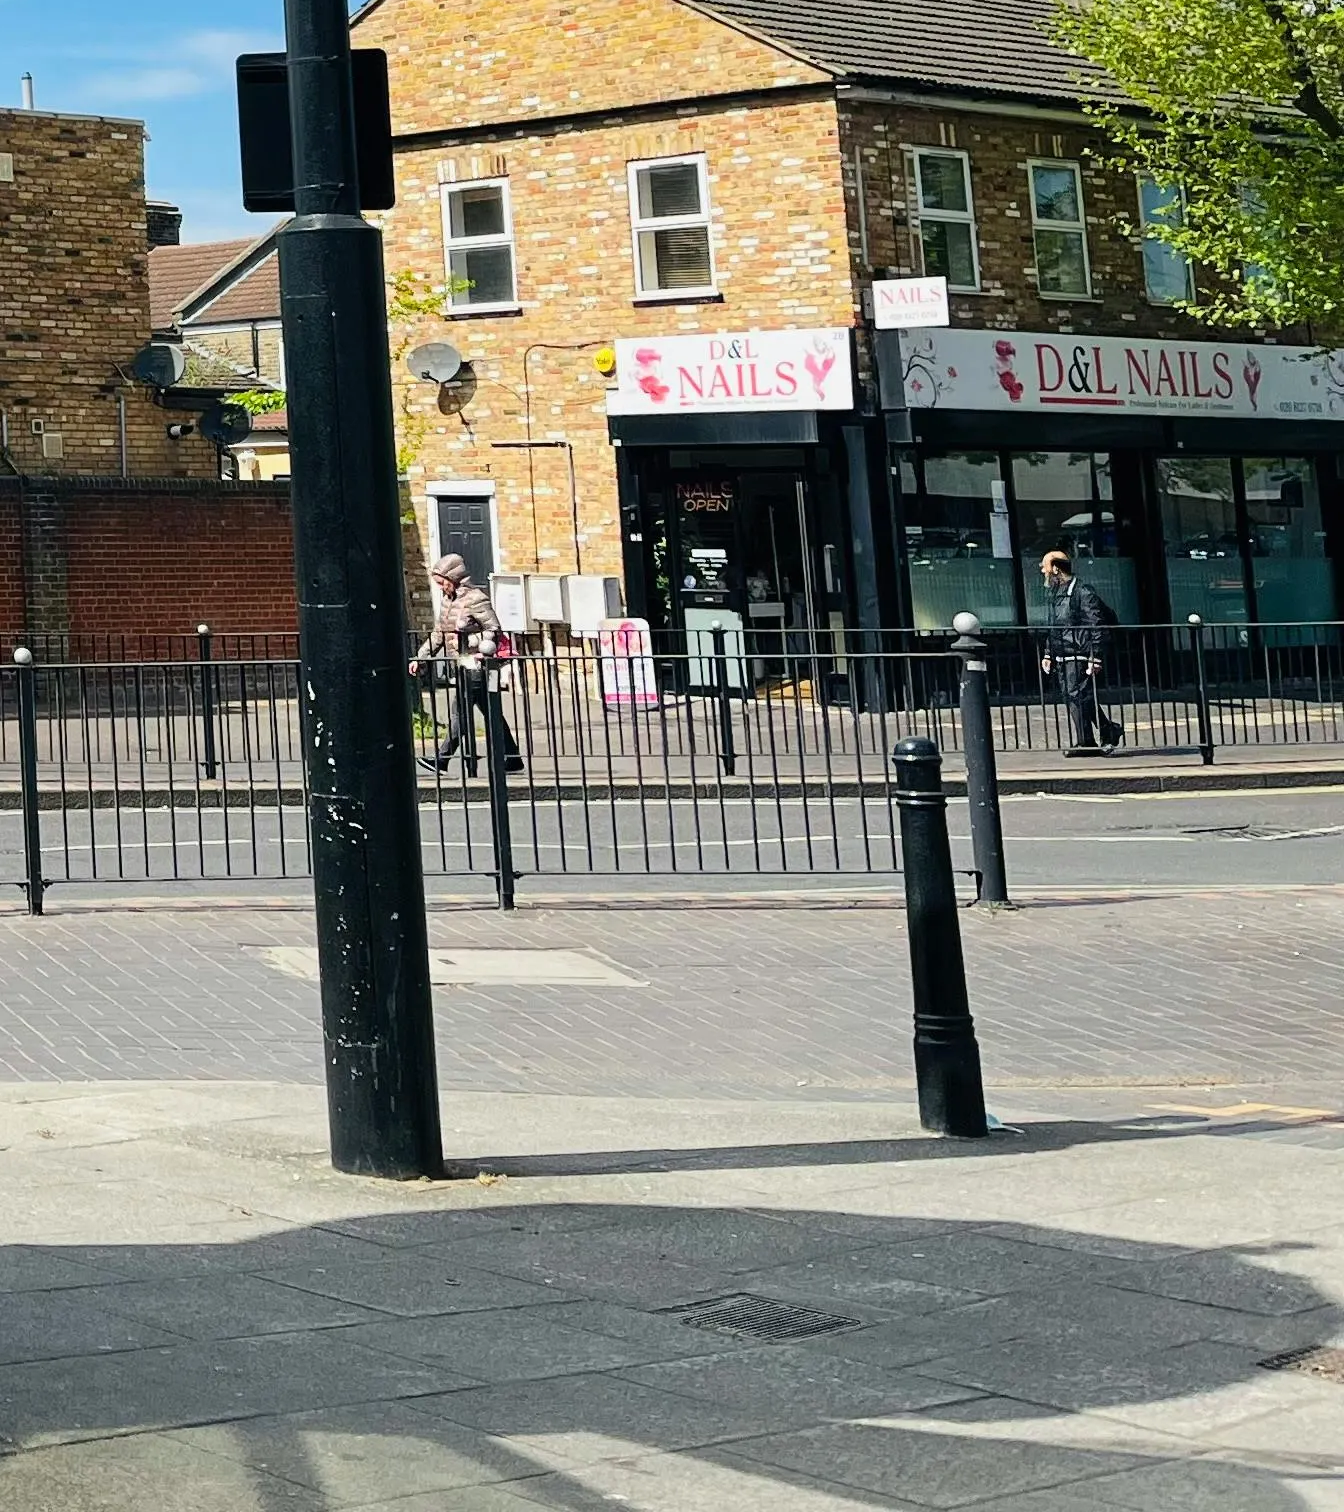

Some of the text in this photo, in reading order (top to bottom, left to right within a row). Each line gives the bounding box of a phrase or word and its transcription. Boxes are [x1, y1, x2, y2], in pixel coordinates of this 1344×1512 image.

[880, 286, 942, 305] NAILS
[709, 338, 759, 361] D&L
[677, 360, 798, 399] NAILS
[1034, 343, 1234, 400] D&L NAILS
[676, 481, 733, 499] NAILS
[683, 499, 730, 512] OPEN
